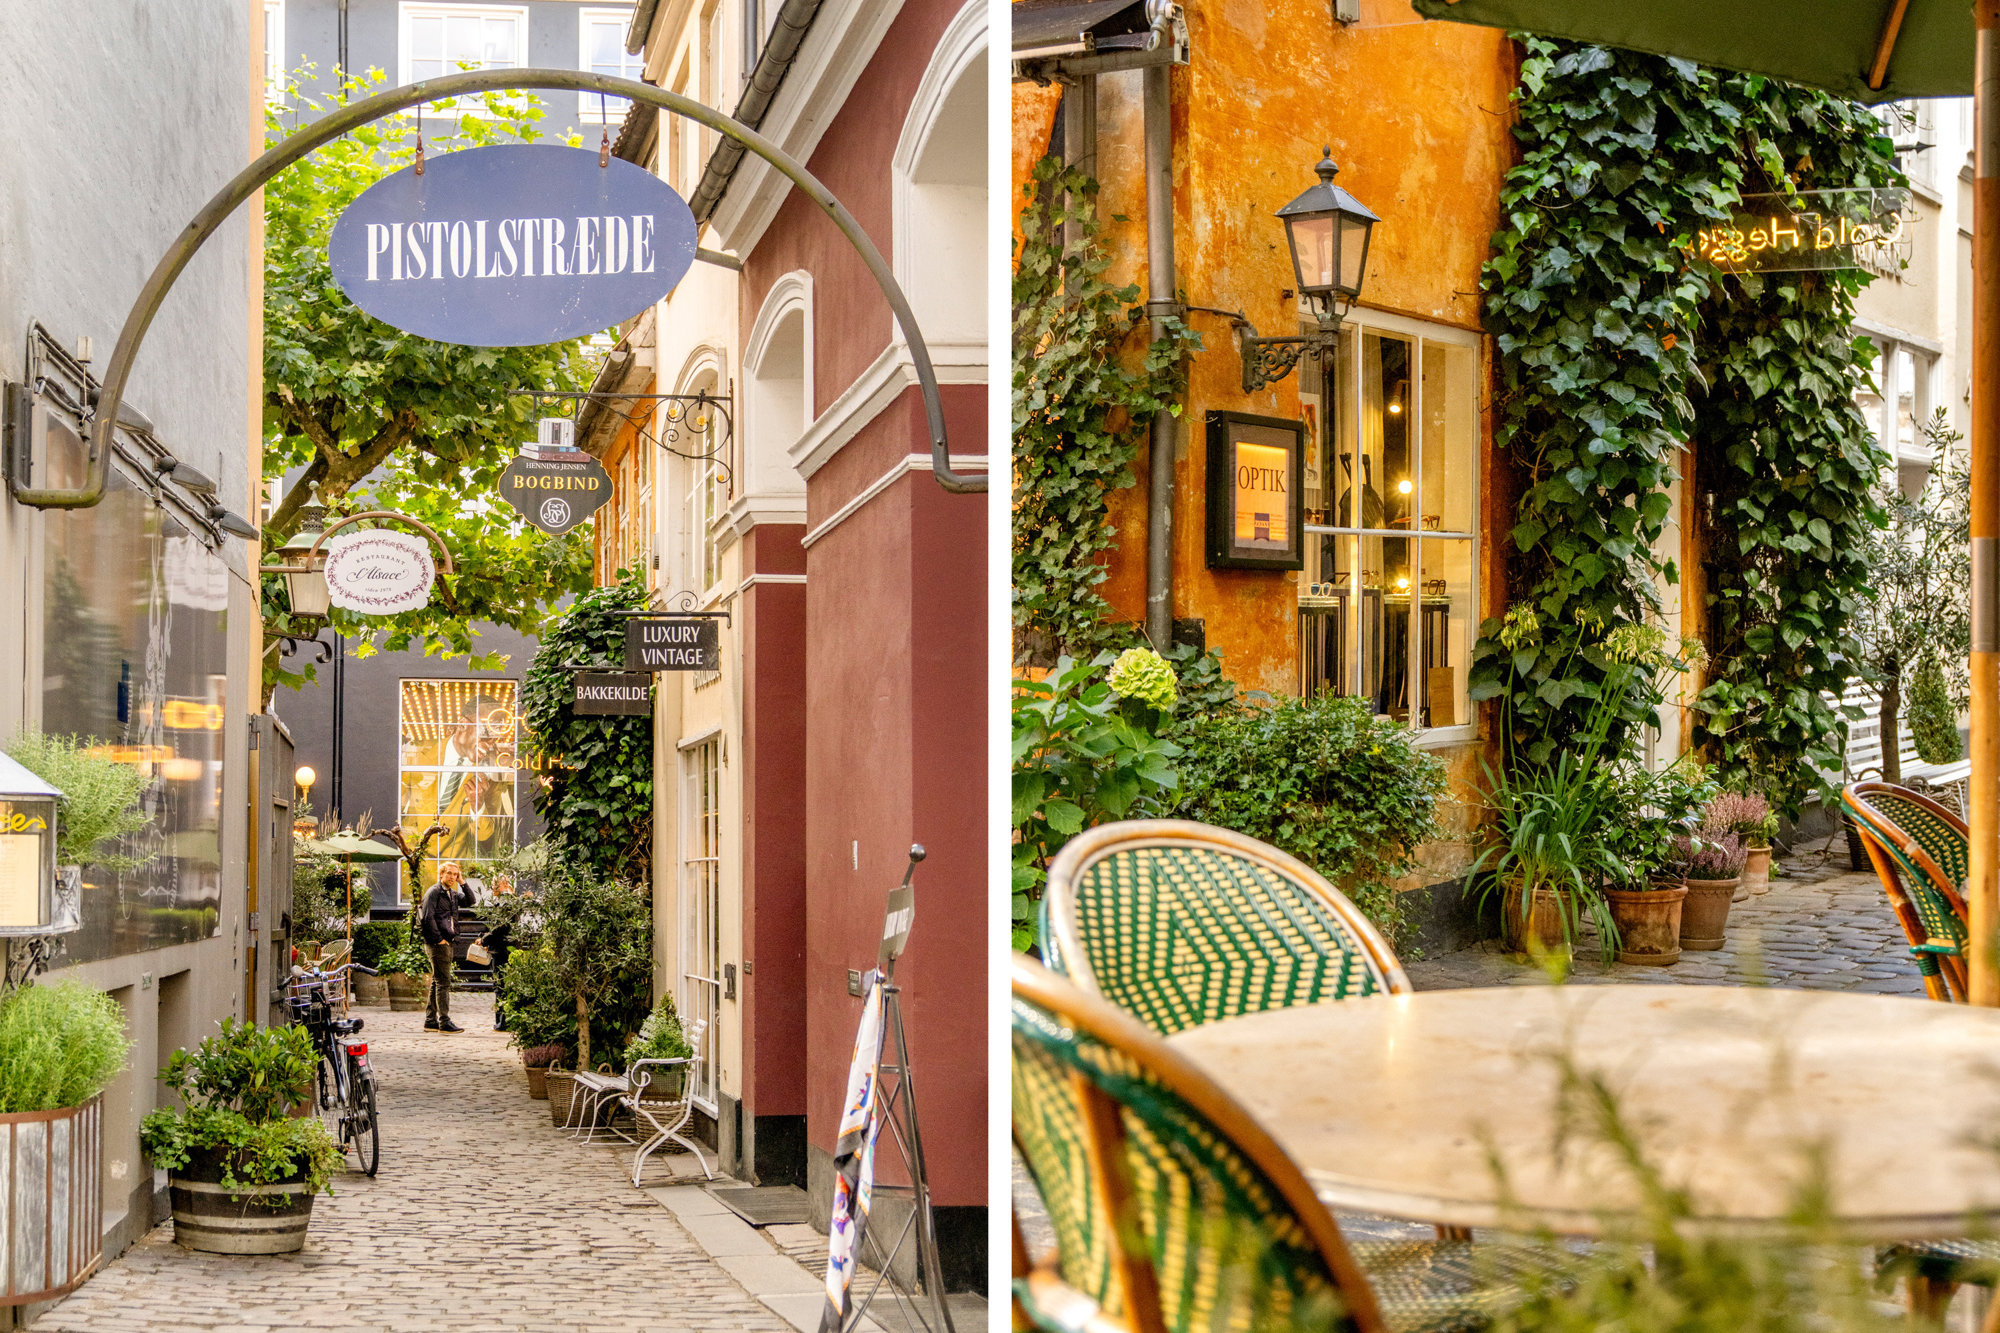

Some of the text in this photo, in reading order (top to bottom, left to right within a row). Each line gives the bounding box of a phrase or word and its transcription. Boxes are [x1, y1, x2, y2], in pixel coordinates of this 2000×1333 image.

[364, 214, 655, 281] PISTOLSTRÆDE
[525, 462, 587, 471] HENNING JENSEN
[513, 475, 600, 491] BOGBIND
[1238, 465, 1286, 493] OPTIK
[356, 554, 406, 566] RESTAURANT
[643, 626, 701, 643] LUXURY
[641, 648, 704, 665] VINTAGE
[576, 686, 648, 700] BAKKEKILDE
[496, 752, 542, 771] Cold
